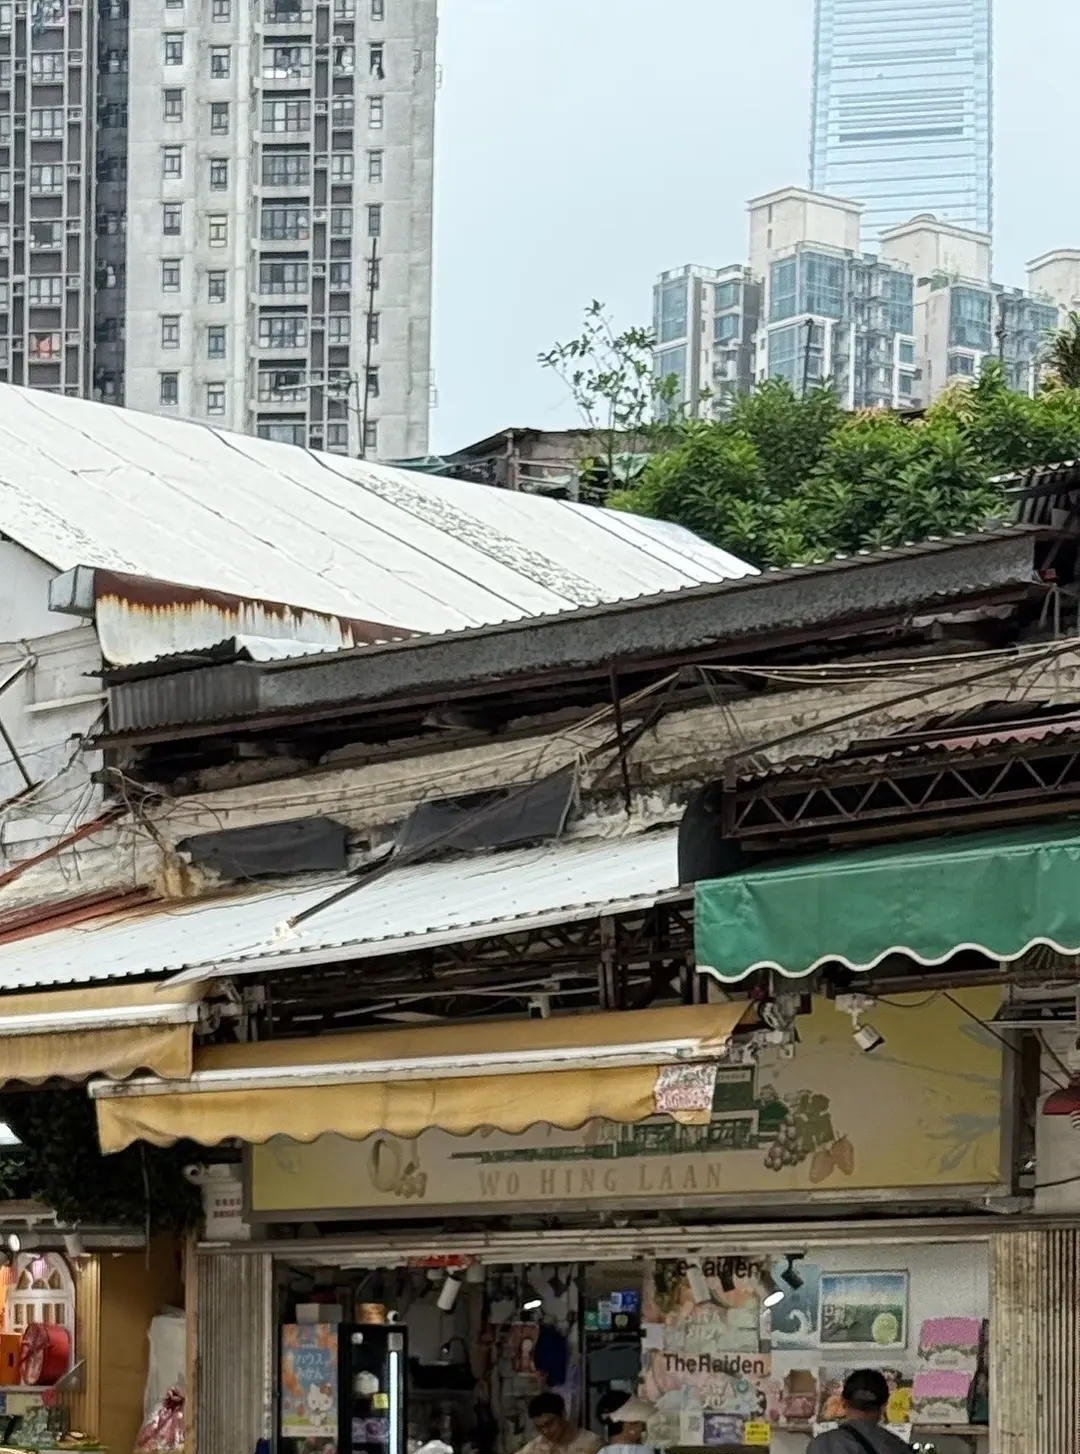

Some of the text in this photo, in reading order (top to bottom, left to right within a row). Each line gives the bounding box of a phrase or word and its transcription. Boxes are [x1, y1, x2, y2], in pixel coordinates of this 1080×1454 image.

[478, 1163, 721, 1196] WO HING LAAN
